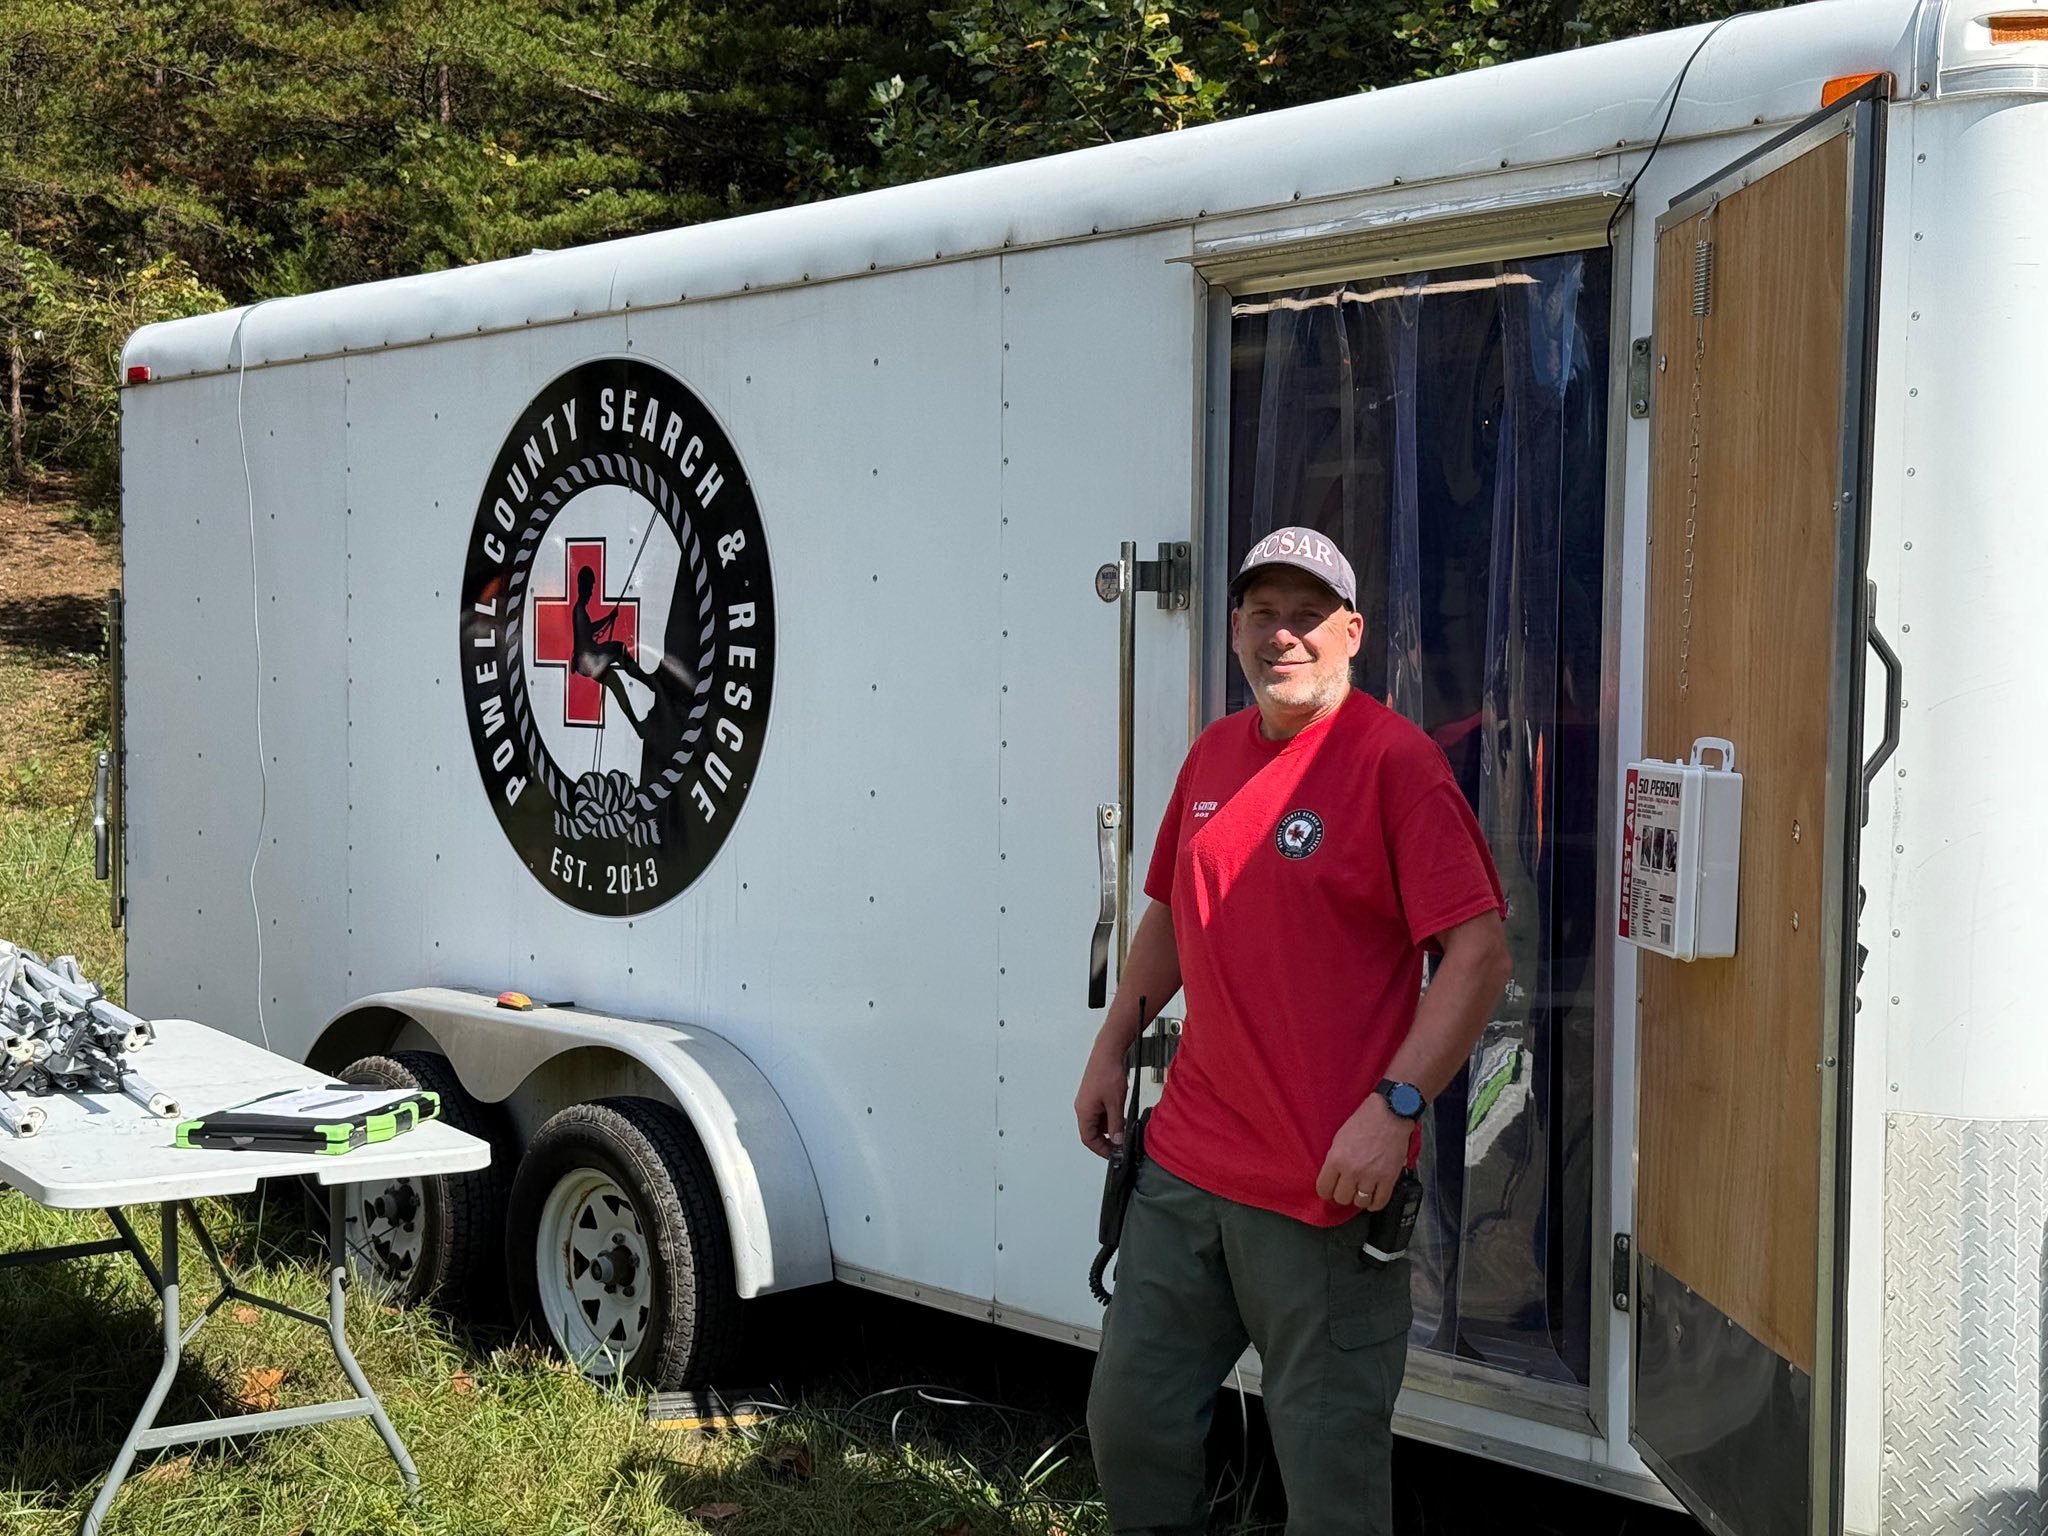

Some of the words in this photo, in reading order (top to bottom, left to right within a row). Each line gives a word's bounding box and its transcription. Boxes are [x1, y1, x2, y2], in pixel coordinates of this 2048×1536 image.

[600, 387, 724, 509] SEARCH
[483, 397, 578, 564] COUNTY
[717, 529, 746, 569] &
[1248, 531, 1333, 566] PCSAR
[473, 597, 527, 807] POWELL
[690, 601, 756, 823] RESCUE
[1626, 781, 1637, 831] AID
[1638, 778, 1650, 794] 50
[1650, 779, 1682, 798] PERSON
[550, 846, 593, 891] EST.
[606, 857, 659, 894] 2013
[1621, 843, 1633, 922] FIRST
